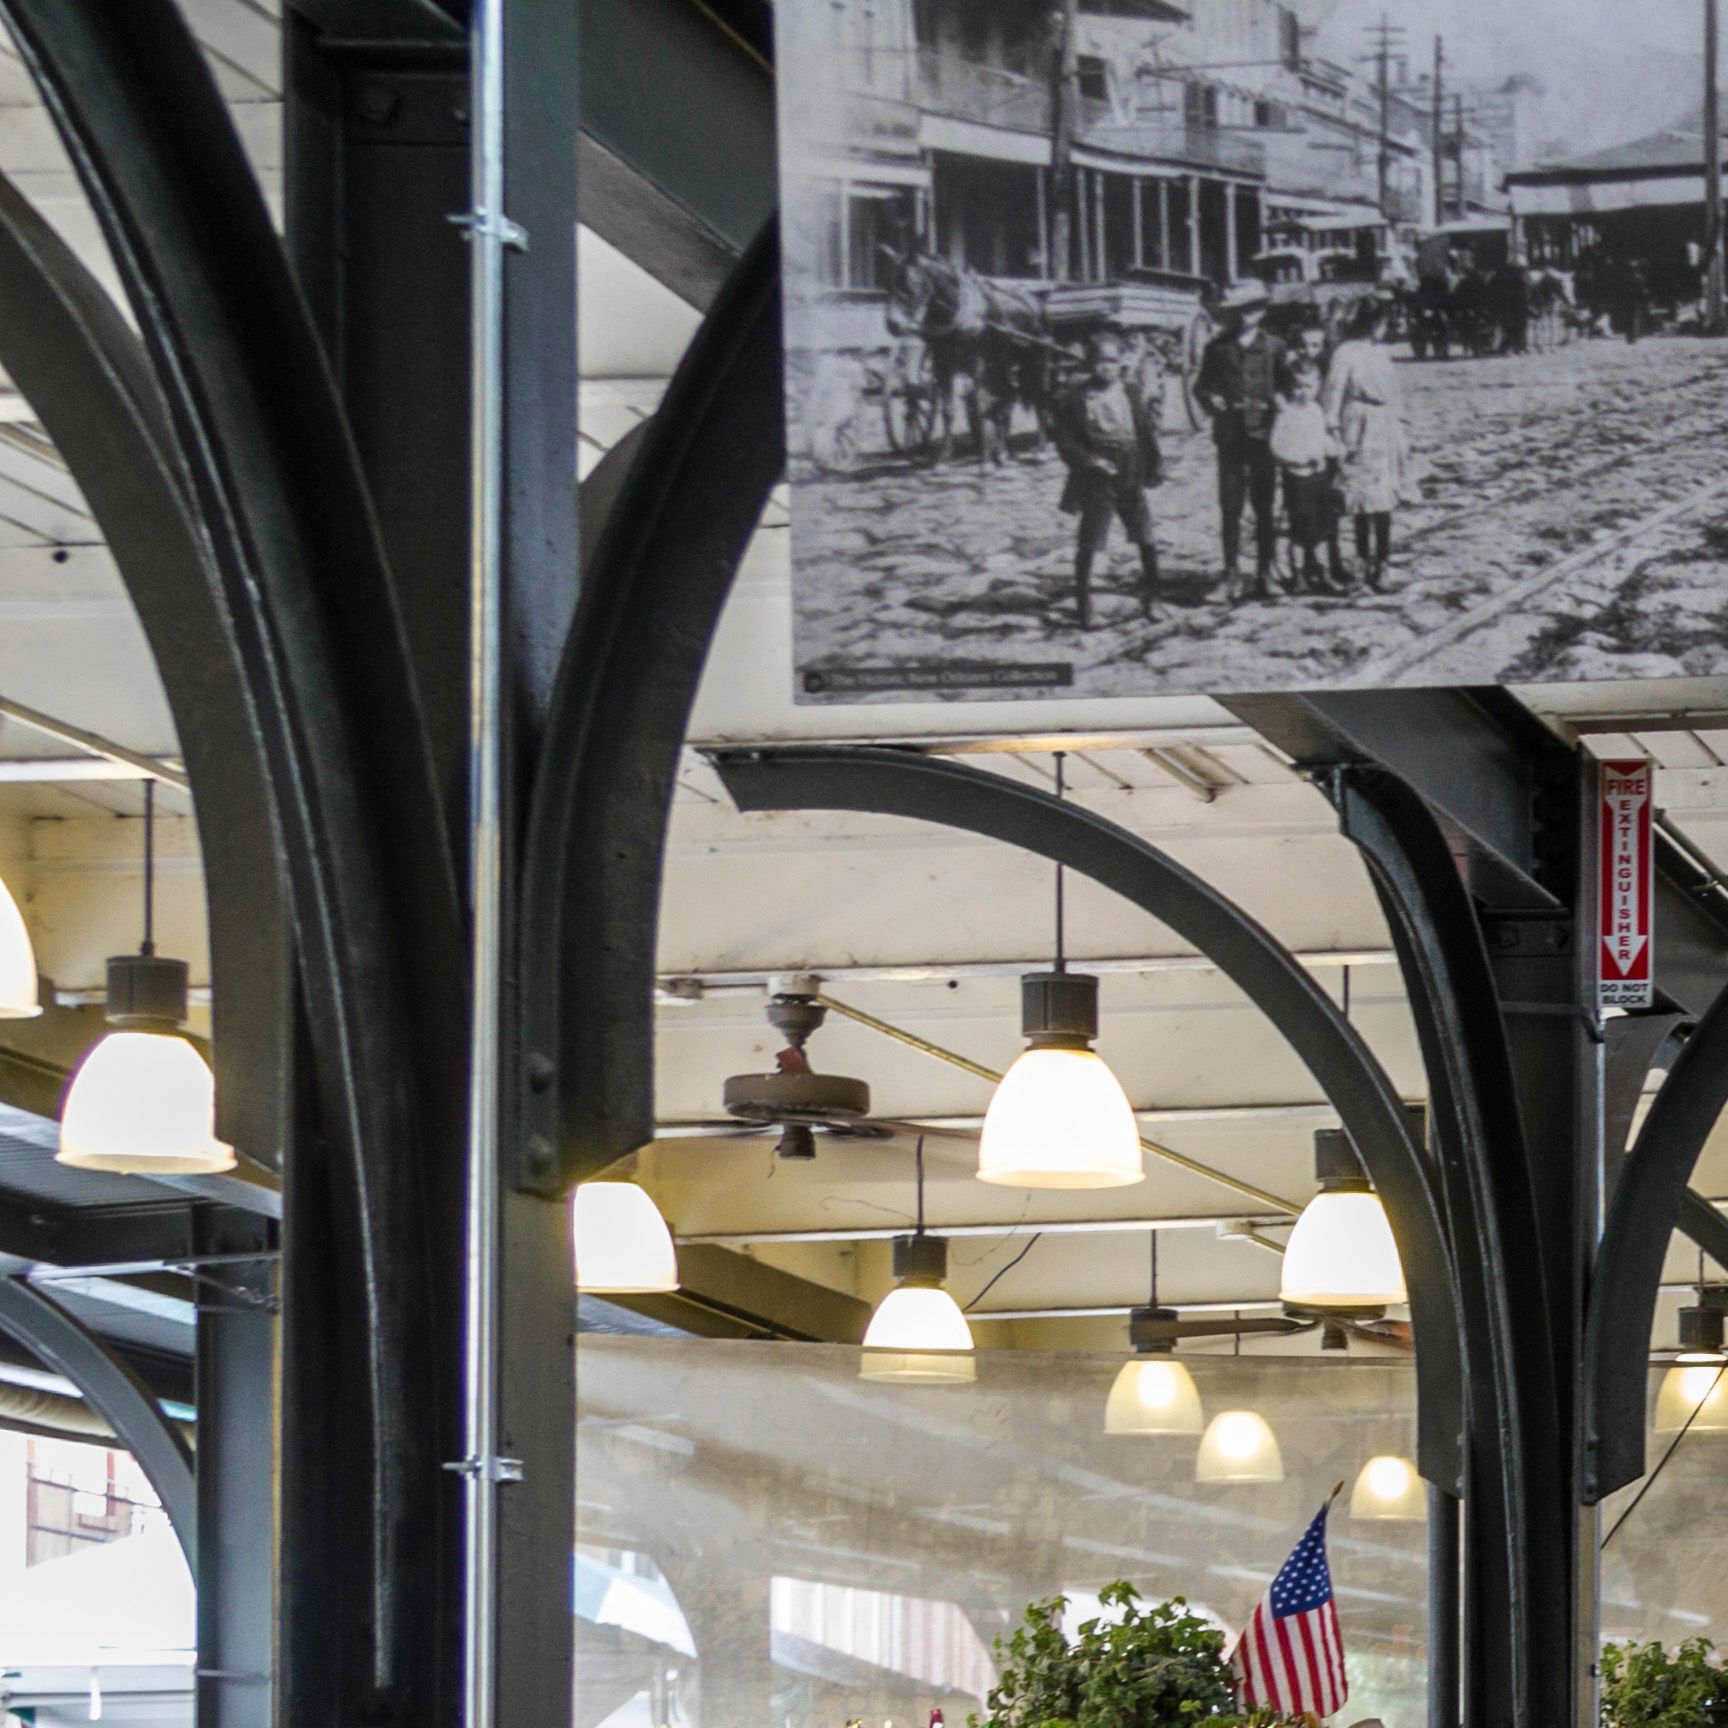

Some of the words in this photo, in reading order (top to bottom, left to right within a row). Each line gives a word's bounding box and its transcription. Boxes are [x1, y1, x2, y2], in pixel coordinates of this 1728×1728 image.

[1607, 779, 1645, 795] FIRE
[1618, 800, 1632, 960] EXTINGUISHER
[1600, 983, 1617, 993] DO
[1621, 982, 1648, 992] NOT
[1602, 994, 1645, 1004] BLOCK
